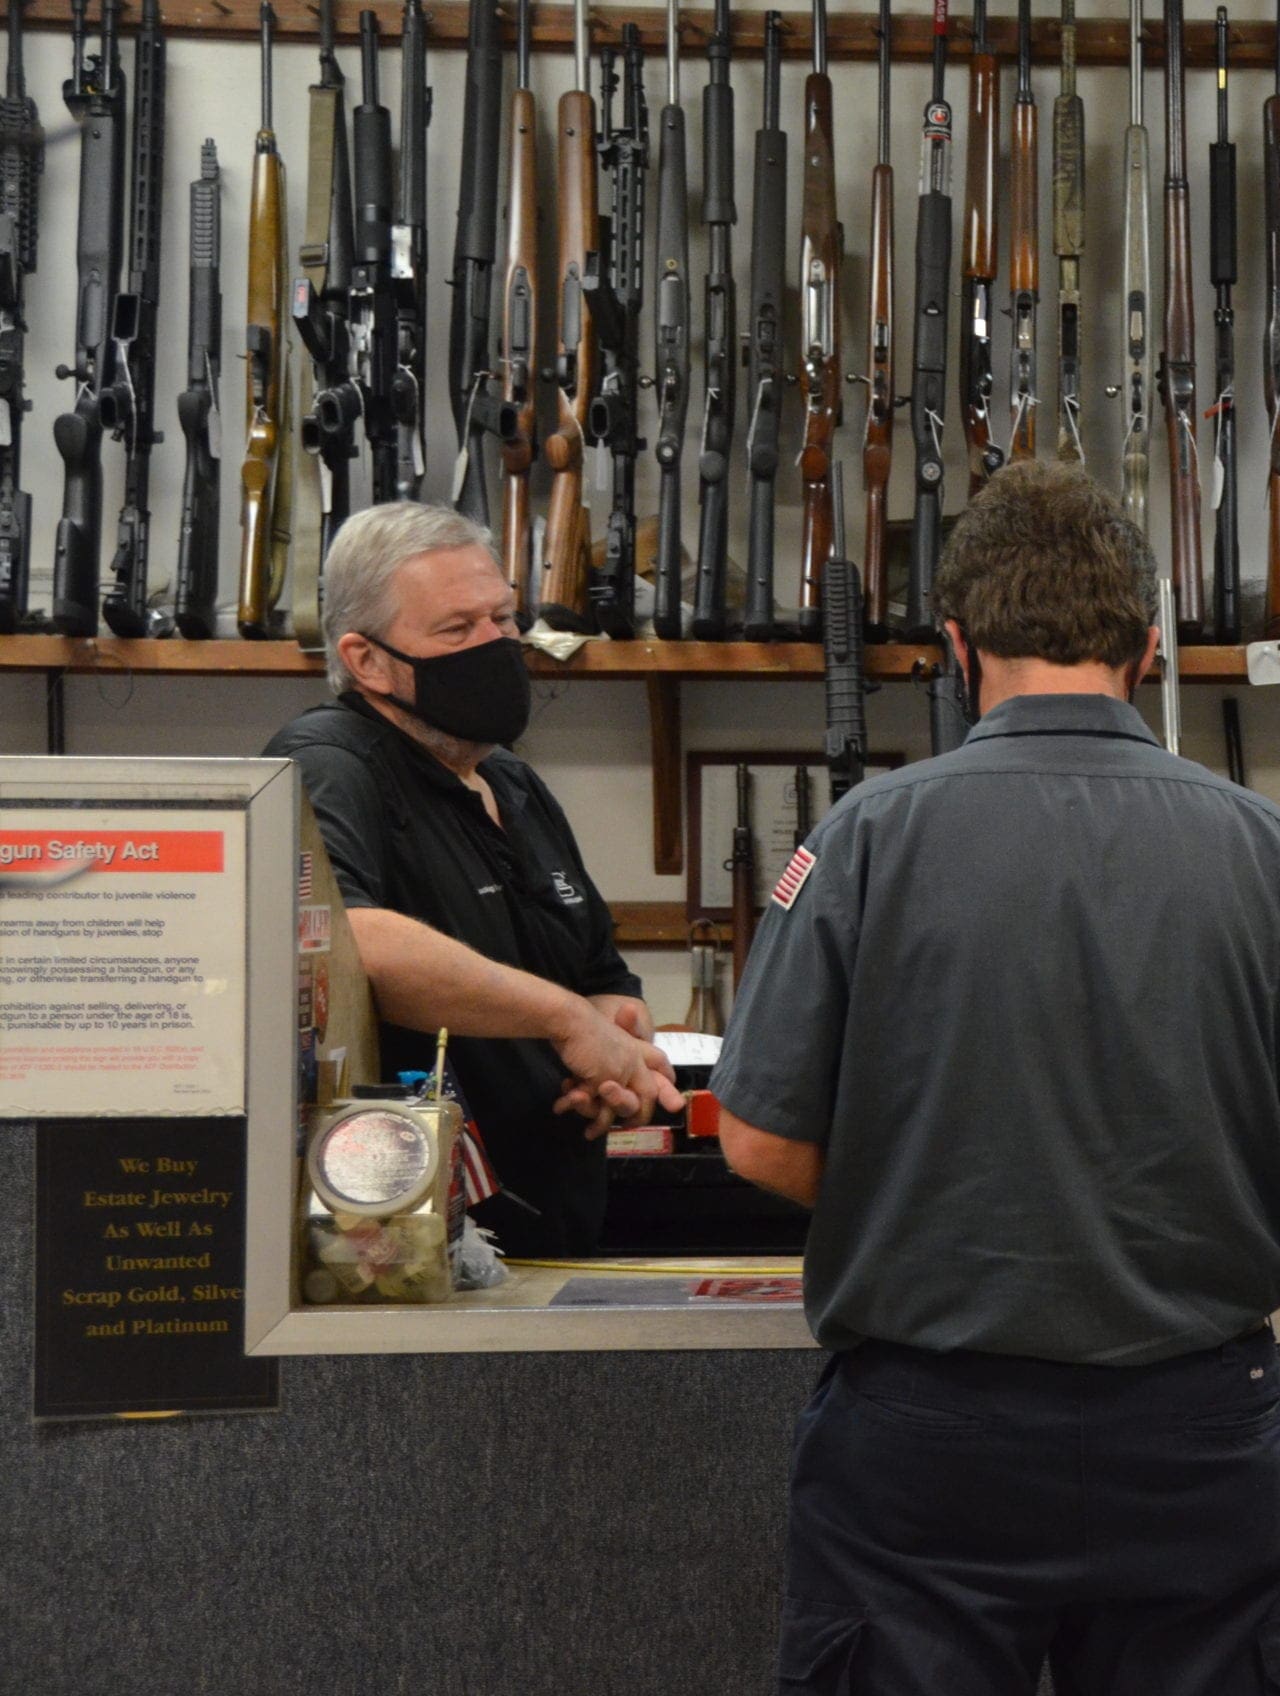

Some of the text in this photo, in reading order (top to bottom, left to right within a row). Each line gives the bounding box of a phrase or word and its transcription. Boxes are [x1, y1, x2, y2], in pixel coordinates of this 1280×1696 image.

[47, 839, 117, 865] Safety
[122, 840, 159, 860] Act
[8, 890, 44, 900] leading
[47, 891, 100, 899] contributor
[115, 891, 153, 901] juvenile
[156, 891, 196, 899] violence
[36, 921, 59, 929] away
[62, 919, 84, 927] from
[87, 919, 124, 927] children
[127, 919, 142, 927] will
[144, 919, 165, 929] help
[21, 928, 31, 936] of
[32, 928, 80, 938] handguns
[83, 928, 94, 938] by
[142, 929, 163, 938] stop
[6, 956, 15, 964] in
[18, 956, 51, 964] certain
[54, 956, 87, 964] limited
[164, 958, 199, 967] anyone
[50, 965, 106, 976] possessing
[178, 967, 195, 976] any
[30, 974, 77, 983] otherwise
[80, 974, 137, 984] transferring
[148, 974, 191, 985] handgun
[49, 1002, 85, 1012] against
[51, 1013, 84, 1022] person
[86, 1011, 115, 1019] under
[117, 1011, 133, 1019] the
[135, 1013, 153, 1022] age
[155, 1011, 165, 1019] of
[168, 1011, 179, 1019] 18
[8, 1020, 62, 1031] punishable
[64, 1020, 76, 1031] by
[79, 1022, 92, 1031] up
[94, 1021, 104, 1029] to
[107, 1020, 118, 1029] 10
[121, 1022, 147, 1031] years
[150, 1020, 159, 1029] in
[119, 1157, 198, 1176] We Buy
[84, 1188, 233, 1208] Estate Jewelry
[105, 1222, 213, 1239] As Well As
[106, 1252, 211, 1271] Unwanted
[63, 1284, 245, 1308] Scrap Gold, Silve
[85, 1317, 229, 1337] and Platinum
